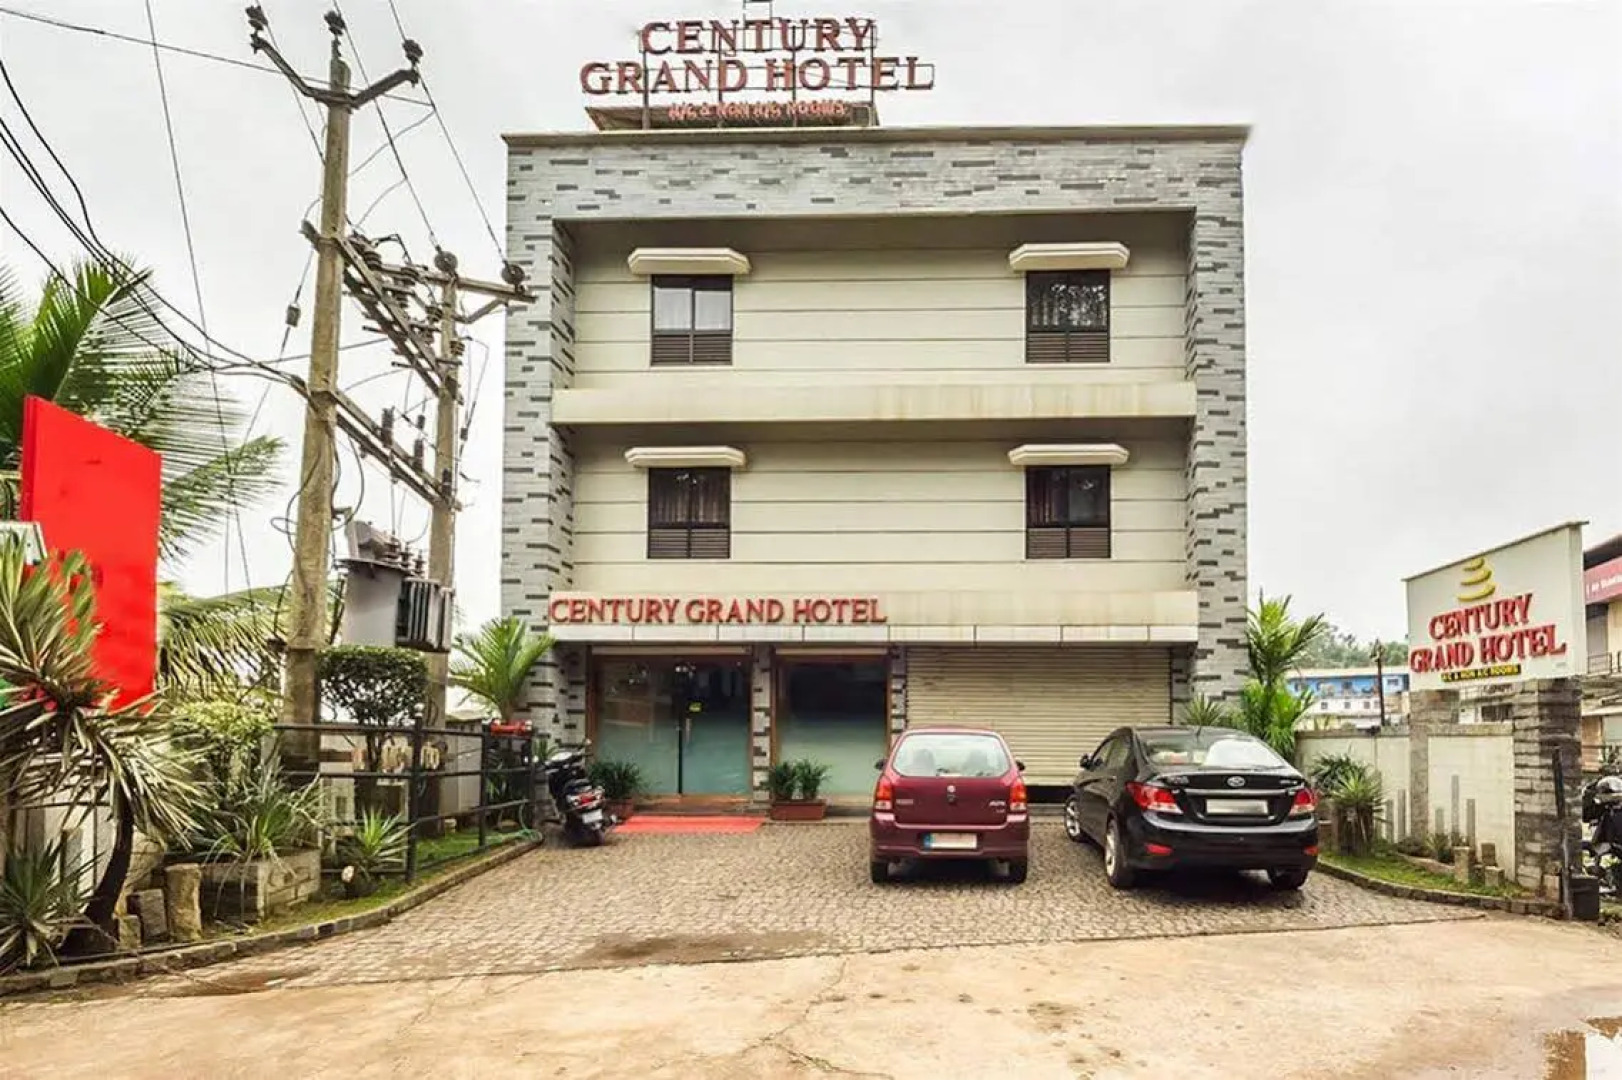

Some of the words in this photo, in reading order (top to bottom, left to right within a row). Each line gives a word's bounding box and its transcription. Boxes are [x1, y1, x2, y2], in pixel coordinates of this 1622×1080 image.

[640, 18, 876, 55] CENTURY
[580, 58, 748, 95] GRAND
[766, 57, 932, 92] HOTEL
[549, 598, 679, 624] CENTURY
[685, 598, 785, 624] GRAND
[792, 598, 887, 624] HOTEL
[1429, 593, 1534, 640] CENTURY
[1410, 641, 1474, 673] GRAND
[1480, 624, 1567, 664] HOTEL
